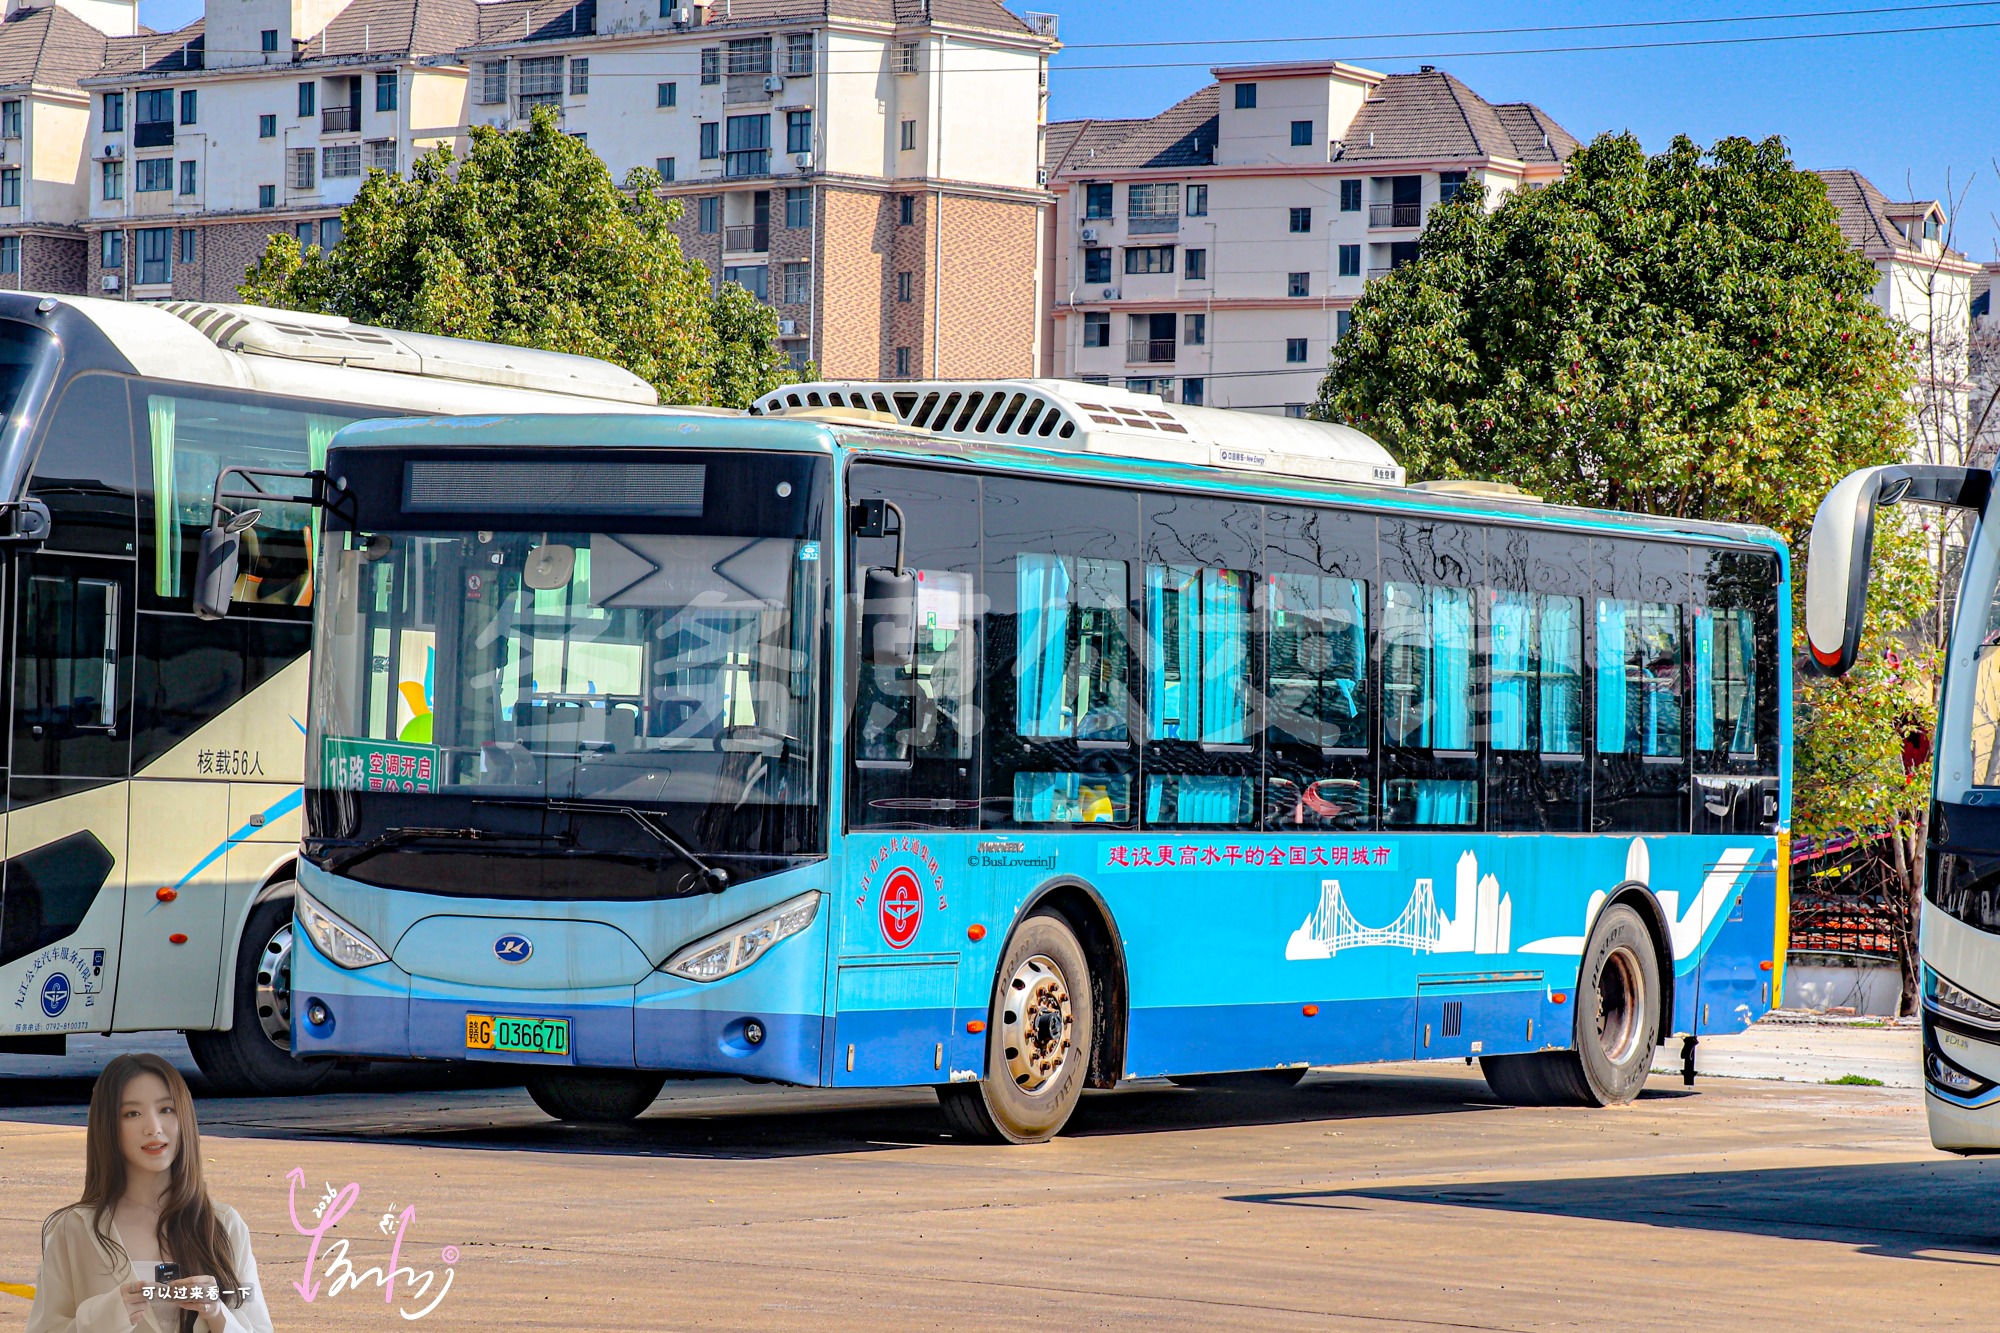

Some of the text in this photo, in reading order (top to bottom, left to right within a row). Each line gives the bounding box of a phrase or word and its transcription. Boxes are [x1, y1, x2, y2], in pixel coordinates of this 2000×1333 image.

[197, 749, 264, 776] 核载56人
[369, 752, 432, 780] 空调开启
[1106, 843, 1391, 868] 建设更高水平的全国文明城市
[855, 836, 948, 912] 九江市公共交通集团公司
[15, 946, 94, 1009] 九江公交汽车服务有限公司
[45, 1021, 89, 1031] 0792-8100373
